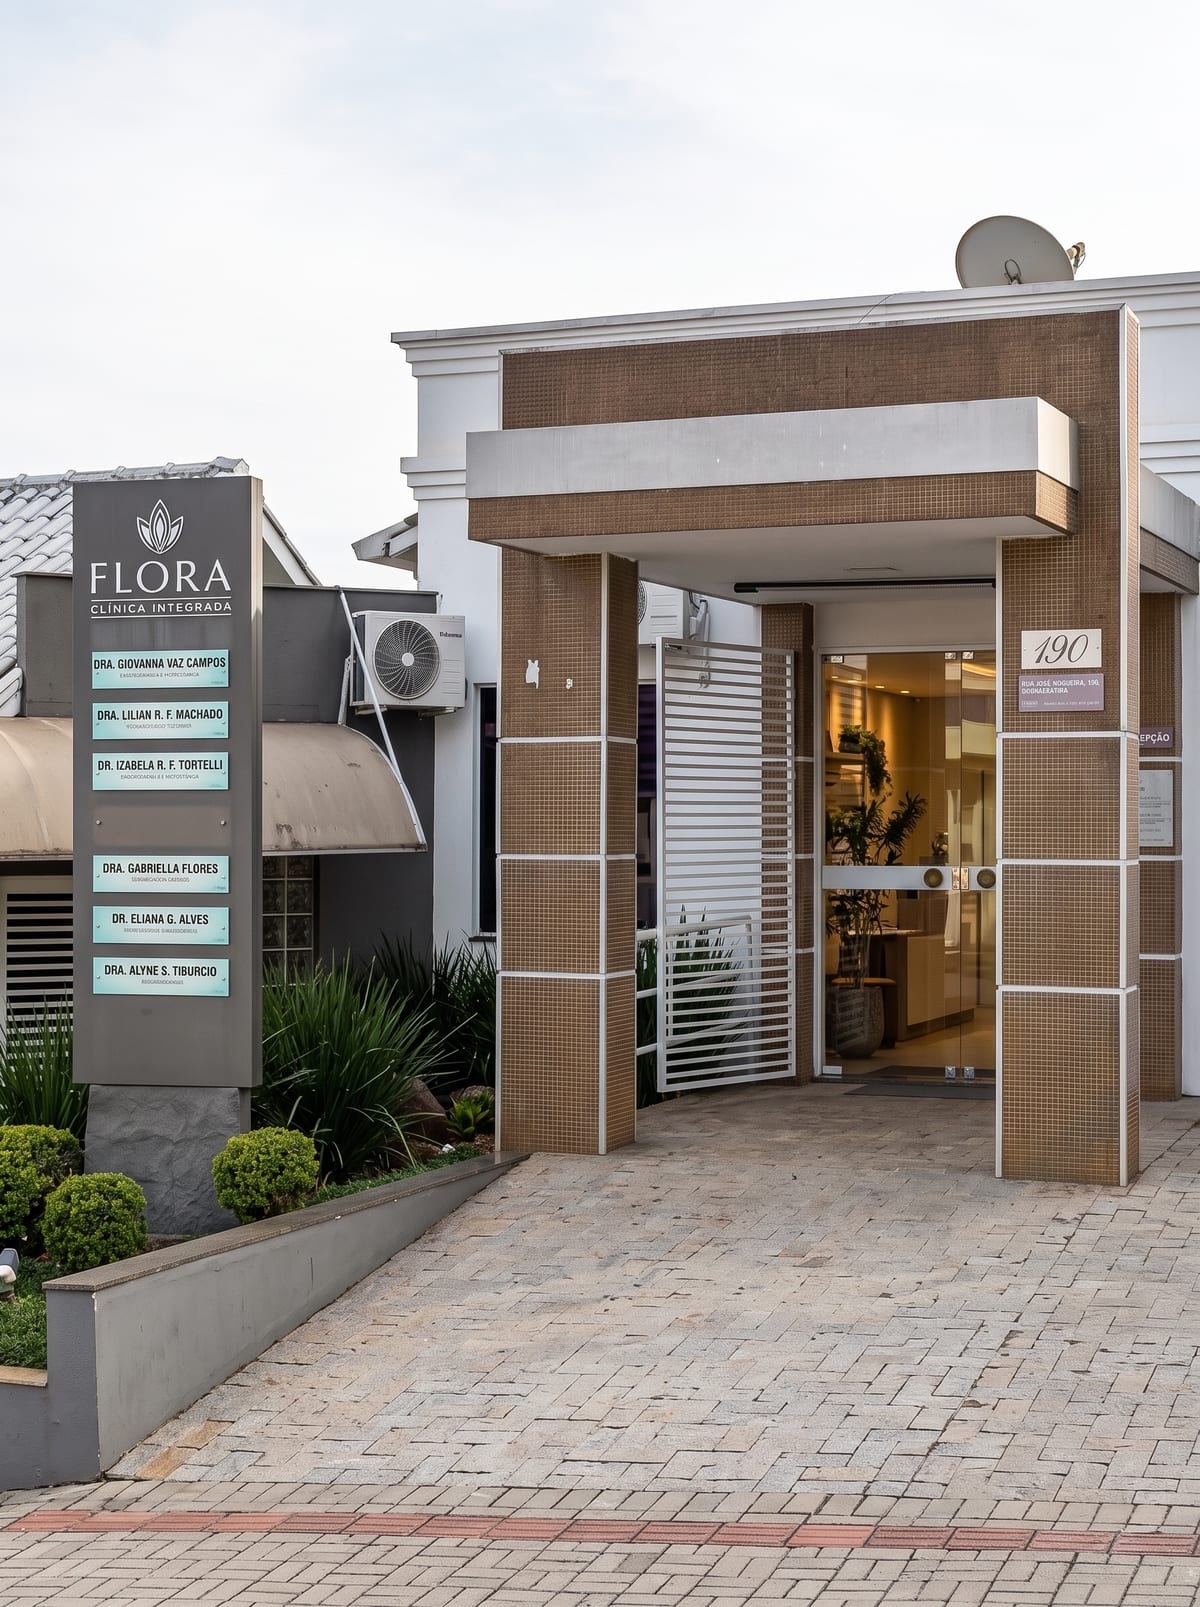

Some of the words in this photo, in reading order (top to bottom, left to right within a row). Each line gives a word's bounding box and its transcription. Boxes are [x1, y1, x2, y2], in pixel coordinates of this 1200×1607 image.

[91, 559, 232, 594] FLORA
[90, 602, 146, 614] CLÍNICA
[152, 602, 232, 613] INTEGRADA
[1034, 634, 1089, 664] 190
[93, 659, 115, 670] DRA.
[117, 658, 165, 669] GIOVANNA
[166, 657, 184, 669] VAZ
[186, 657, 226, 668] CAMPOS
[1036, 679, 1051, 687] JOSÉ
[1052, 679, 1086, 687] NOGUEIRA,
[97, 710, 120, 721] DRA.
[122, 710, 152, 721] LILIAN
[154, 709, 164, 720] R.
[166, 709, 173, 720] F.
[175, 708, 223, 720] MACHADO
[97, 760, 114, 771] DR.
[116, 760, 155, 771] IZABELA
[157, 760, 166, 770] R.
[169, 760, 176, 770] F.
[178, 759, 223, 770] TORTELLI
[103, 863, 125, 874] DRA.
[128, 863, 180, 874] GABRIELLA
[182, 863, 218, 874] FLORES
[112, 913, 128, 924] DR.
[131, 913, 164, 924] ELIANA
[167, 913, 176, 924] G.
[179, 914, 209, 925] ALVES
[104, 965, 126, 976] DRA.
[129, 965, 159, 976] ALYNE
[161, 965, 170, 976] S.
[172, 965, 217, 977] TIBURCIO
